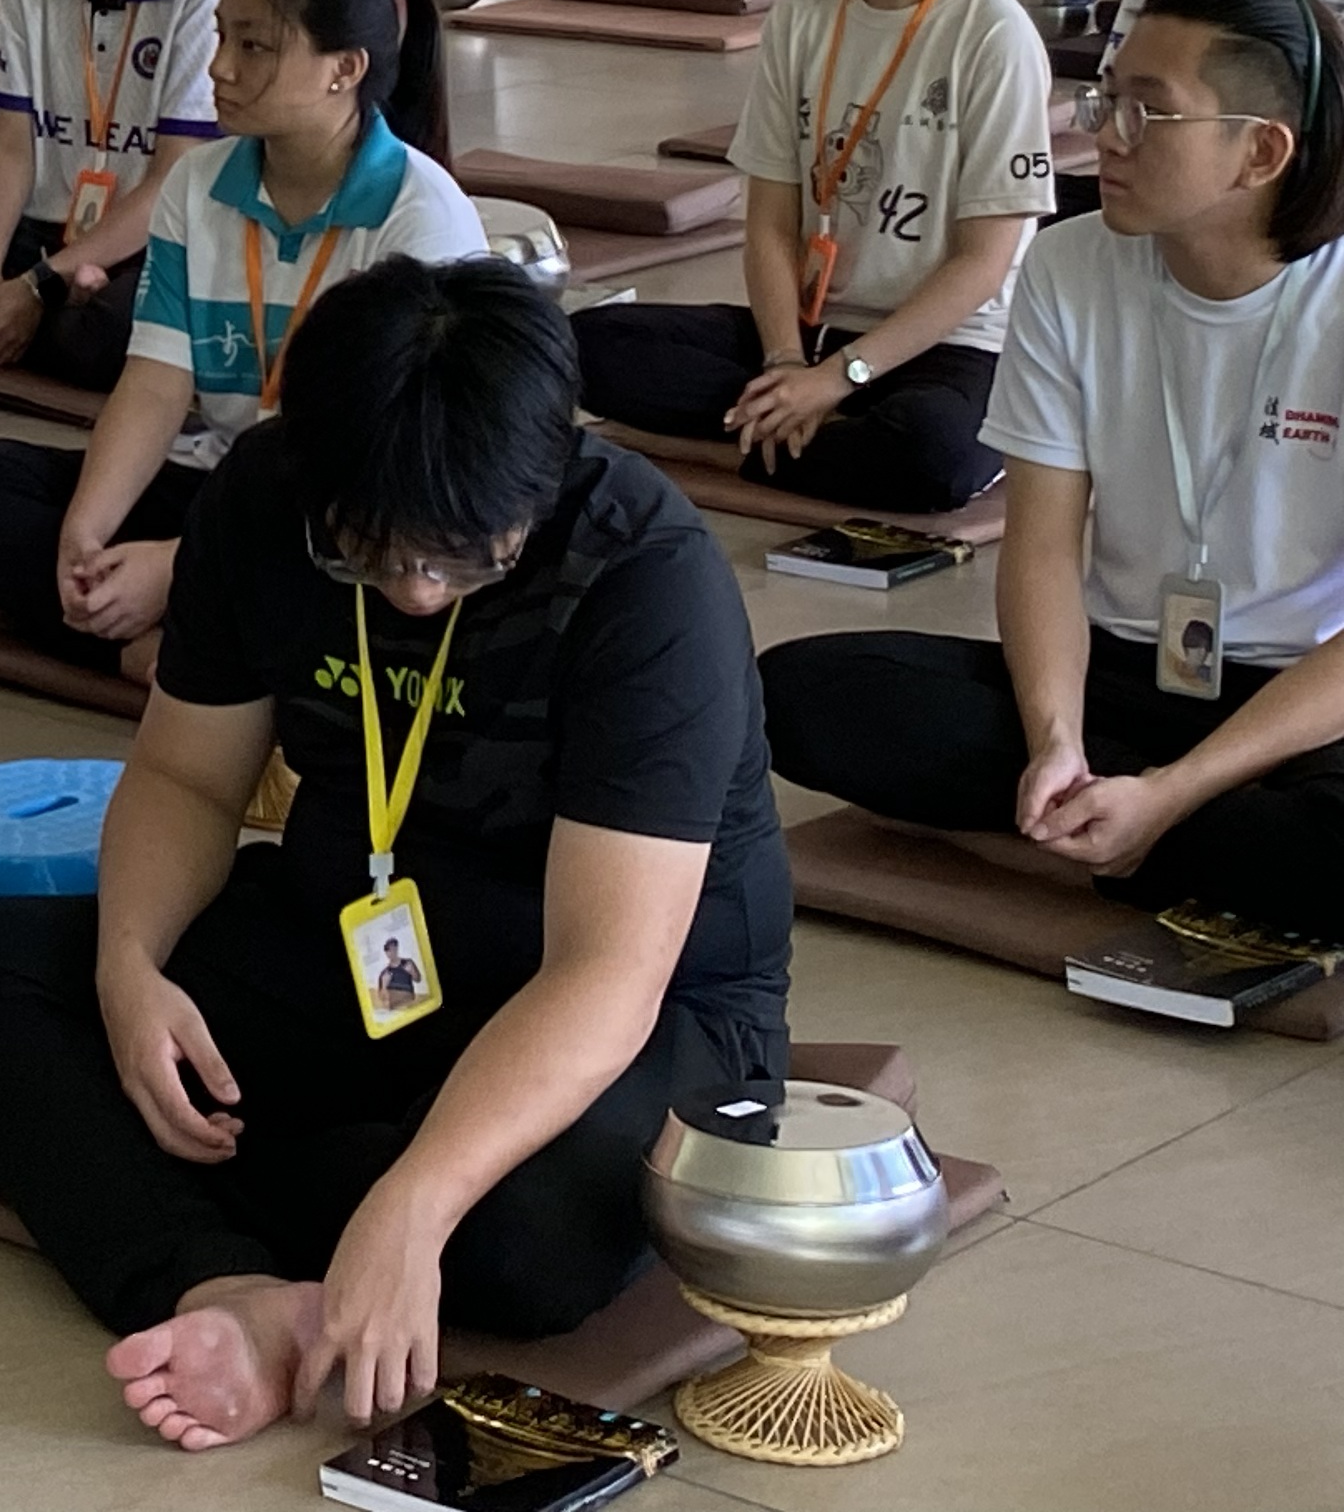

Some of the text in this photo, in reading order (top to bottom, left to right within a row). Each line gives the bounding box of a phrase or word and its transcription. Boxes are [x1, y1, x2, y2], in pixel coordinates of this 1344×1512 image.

[1010, 151, 1051, 180] 05
[878, 184, 929, 242] 42
[1282, 426, 1330, 442] EARTH
